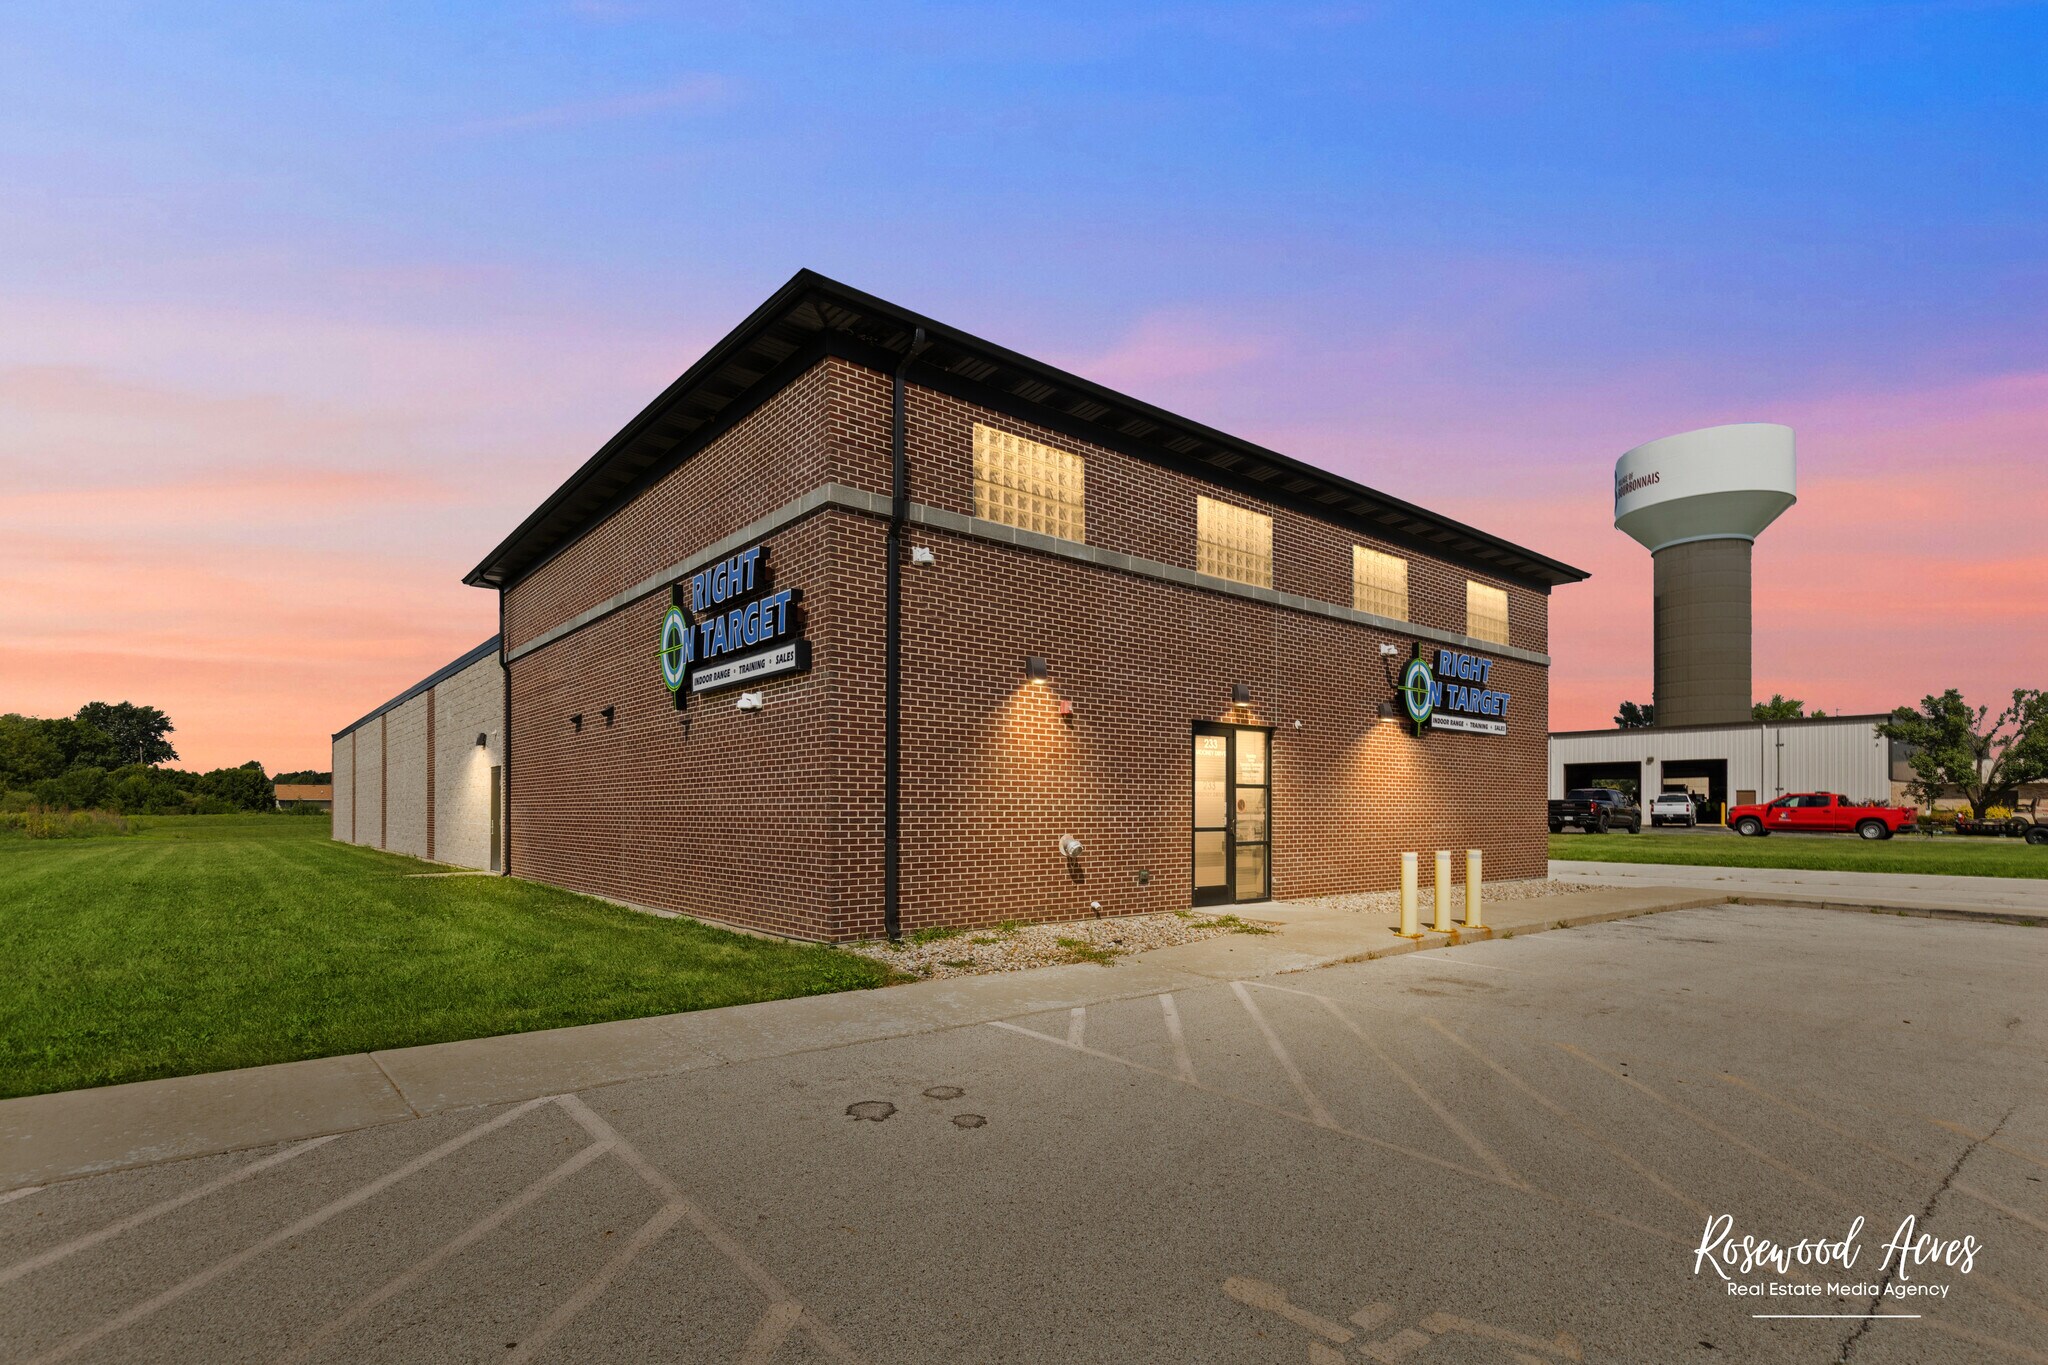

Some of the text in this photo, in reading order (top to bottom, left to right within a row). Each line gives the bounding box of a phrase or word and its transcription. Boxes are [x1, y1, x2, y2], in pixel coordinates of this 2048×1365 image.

[692, 545, 760, 614] RIGHT
[701, 588, 791, 659] TARGET
[694, 650, 794, 687] INDOOR RANGE TRAINING SALES
[1439, 649, 1493, 684] RIGHT
[1446, 684, 1511, 716] TARGET
[1432, 717, 1449, 726] INDOOR
[1450, 719, 1464, 727] RANGE
[1469, 721, 1489, 730] TRAINING
[1203, 738, 1218, 749] 233
